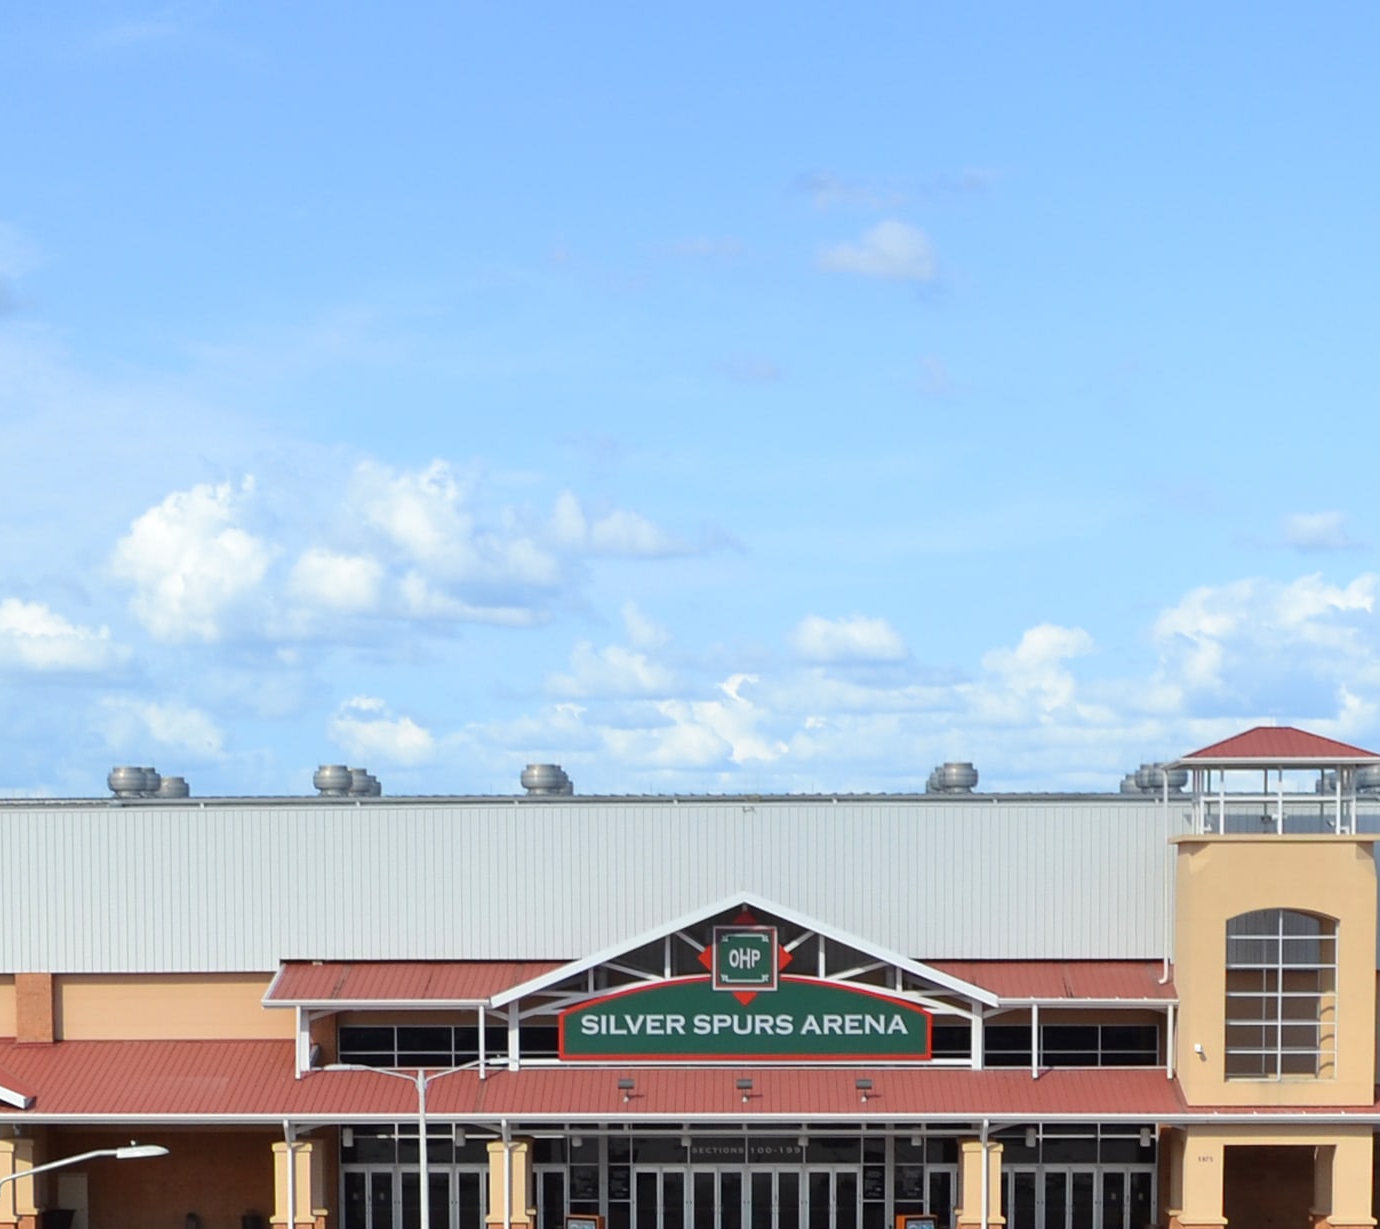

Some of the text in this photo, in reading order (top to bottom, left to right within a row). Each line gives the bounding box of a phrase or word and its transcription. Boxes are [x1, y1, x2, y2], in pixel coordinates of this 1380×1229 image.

[729, 948, 761, 969] OHP
[581, 1014, 909, 1035] SILVER SPURS ARENA
[691, 1146, 744, 1154] SECTIONS
